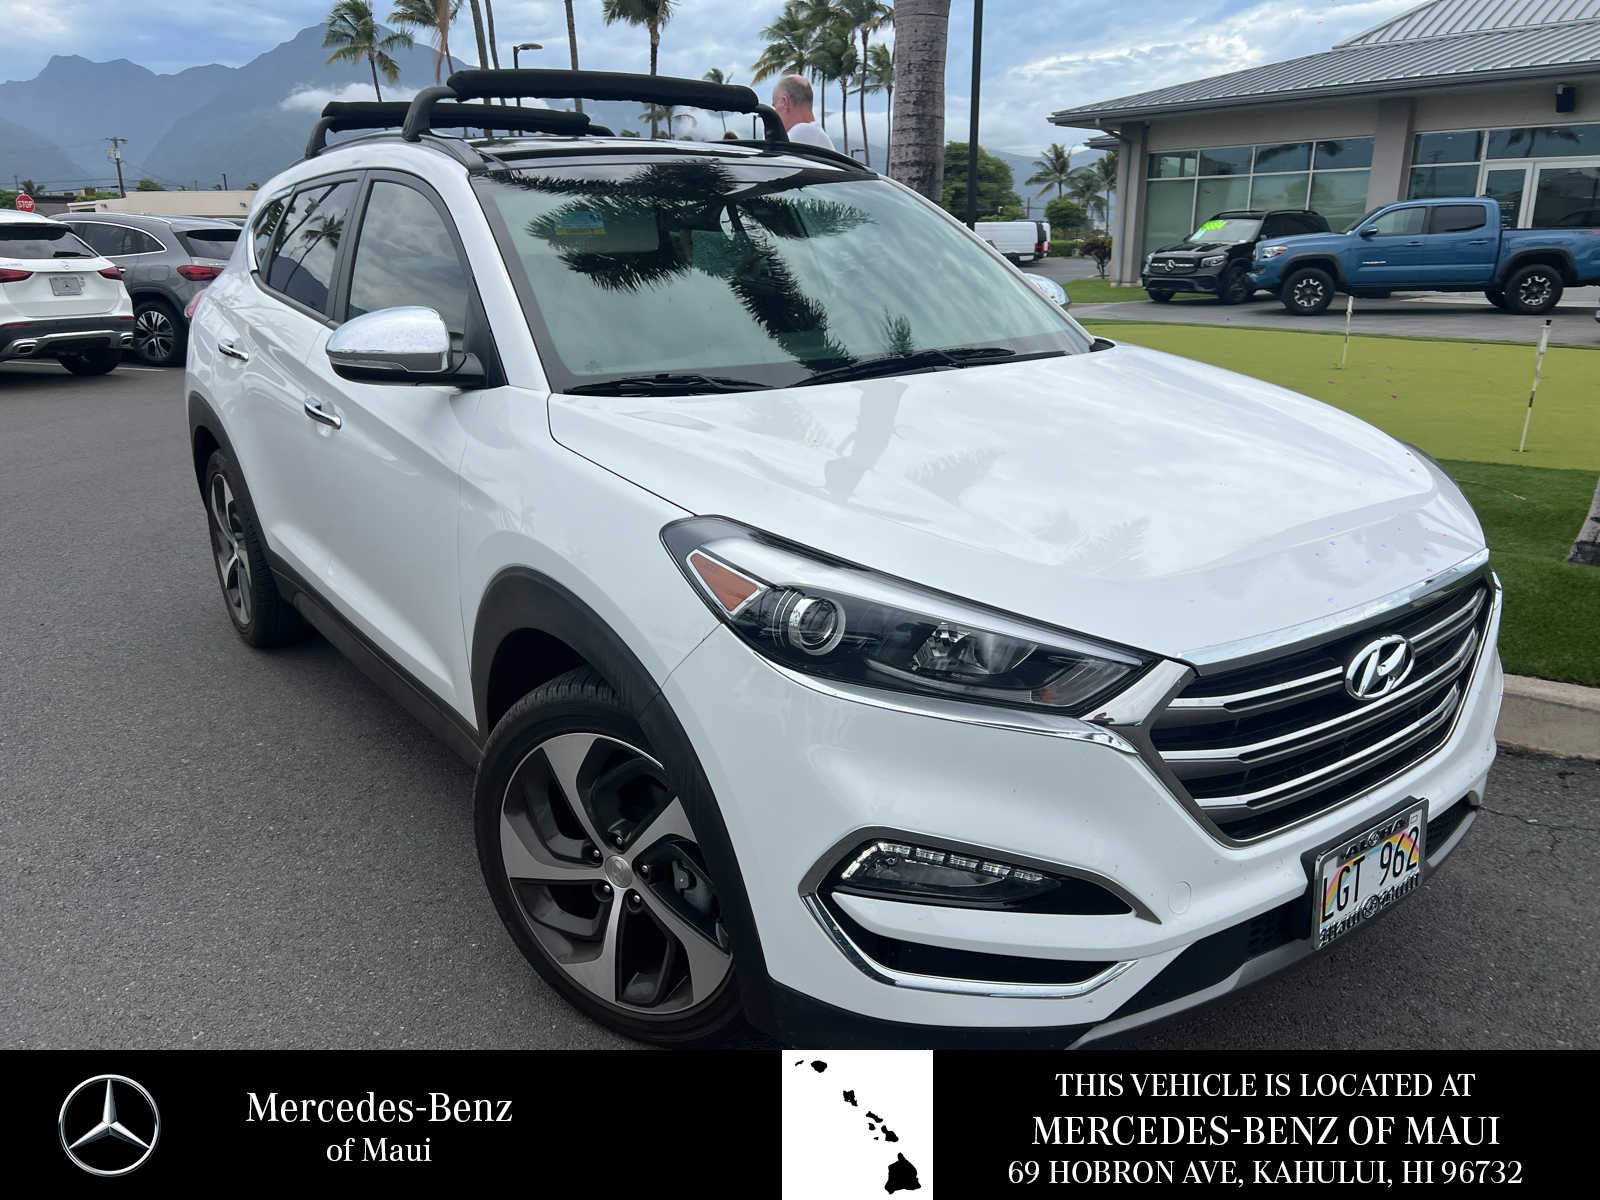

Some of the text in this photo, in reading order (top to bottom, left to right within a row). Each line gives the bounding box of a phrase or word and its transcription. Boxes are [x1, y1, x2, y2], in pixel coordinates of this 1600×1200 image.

[17, 200, 33, 209] STOP
[1321, 855, 1366, 923] LGT
[1379, 826, 1419, 886] 962
